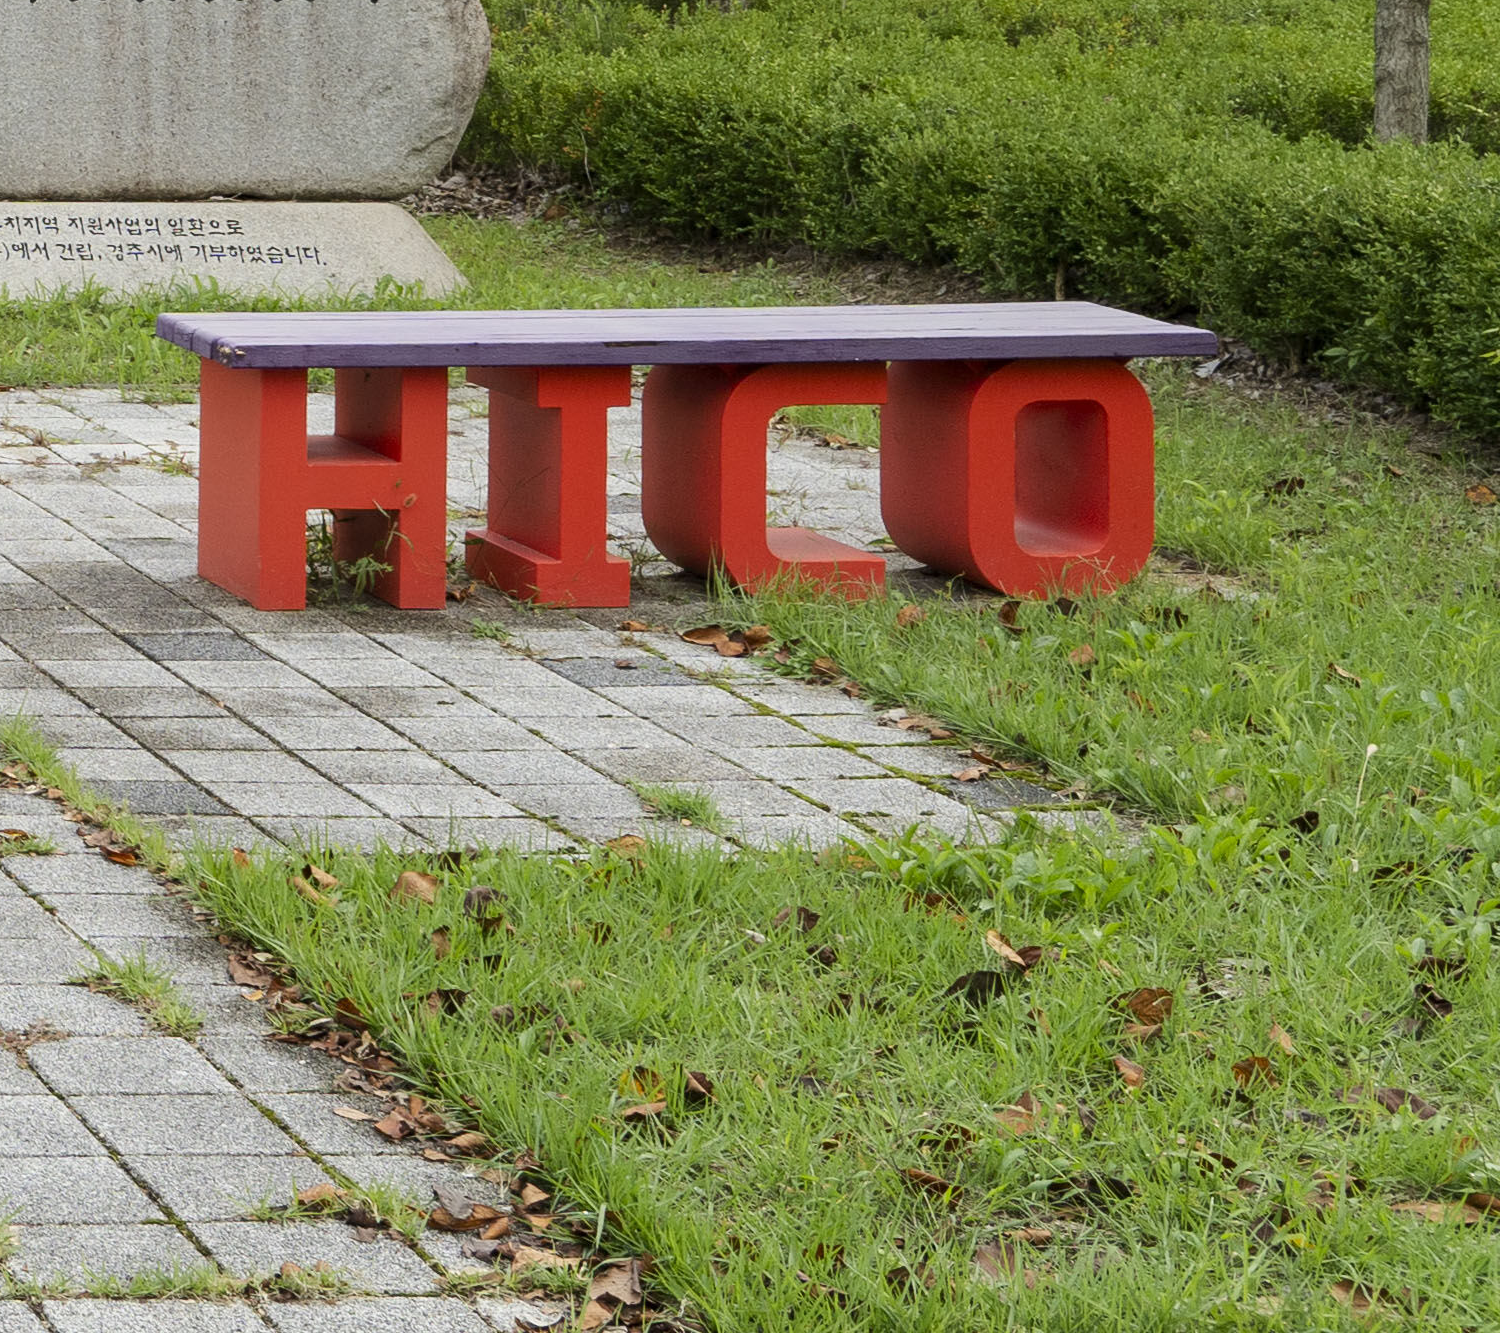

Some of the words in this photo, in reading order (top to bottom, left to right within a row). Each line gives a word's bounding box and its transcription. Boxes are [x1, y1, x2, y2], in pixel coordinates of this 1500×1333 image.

[68, 216, 161, 237] 지원사업의
[168, 217, 245, 237] 일환으로
[107, 243, 182, 263] 경주시에
[189, 244, 328, 266] 기부하였습니다.
[198, 360, 1155, 611] HICO
